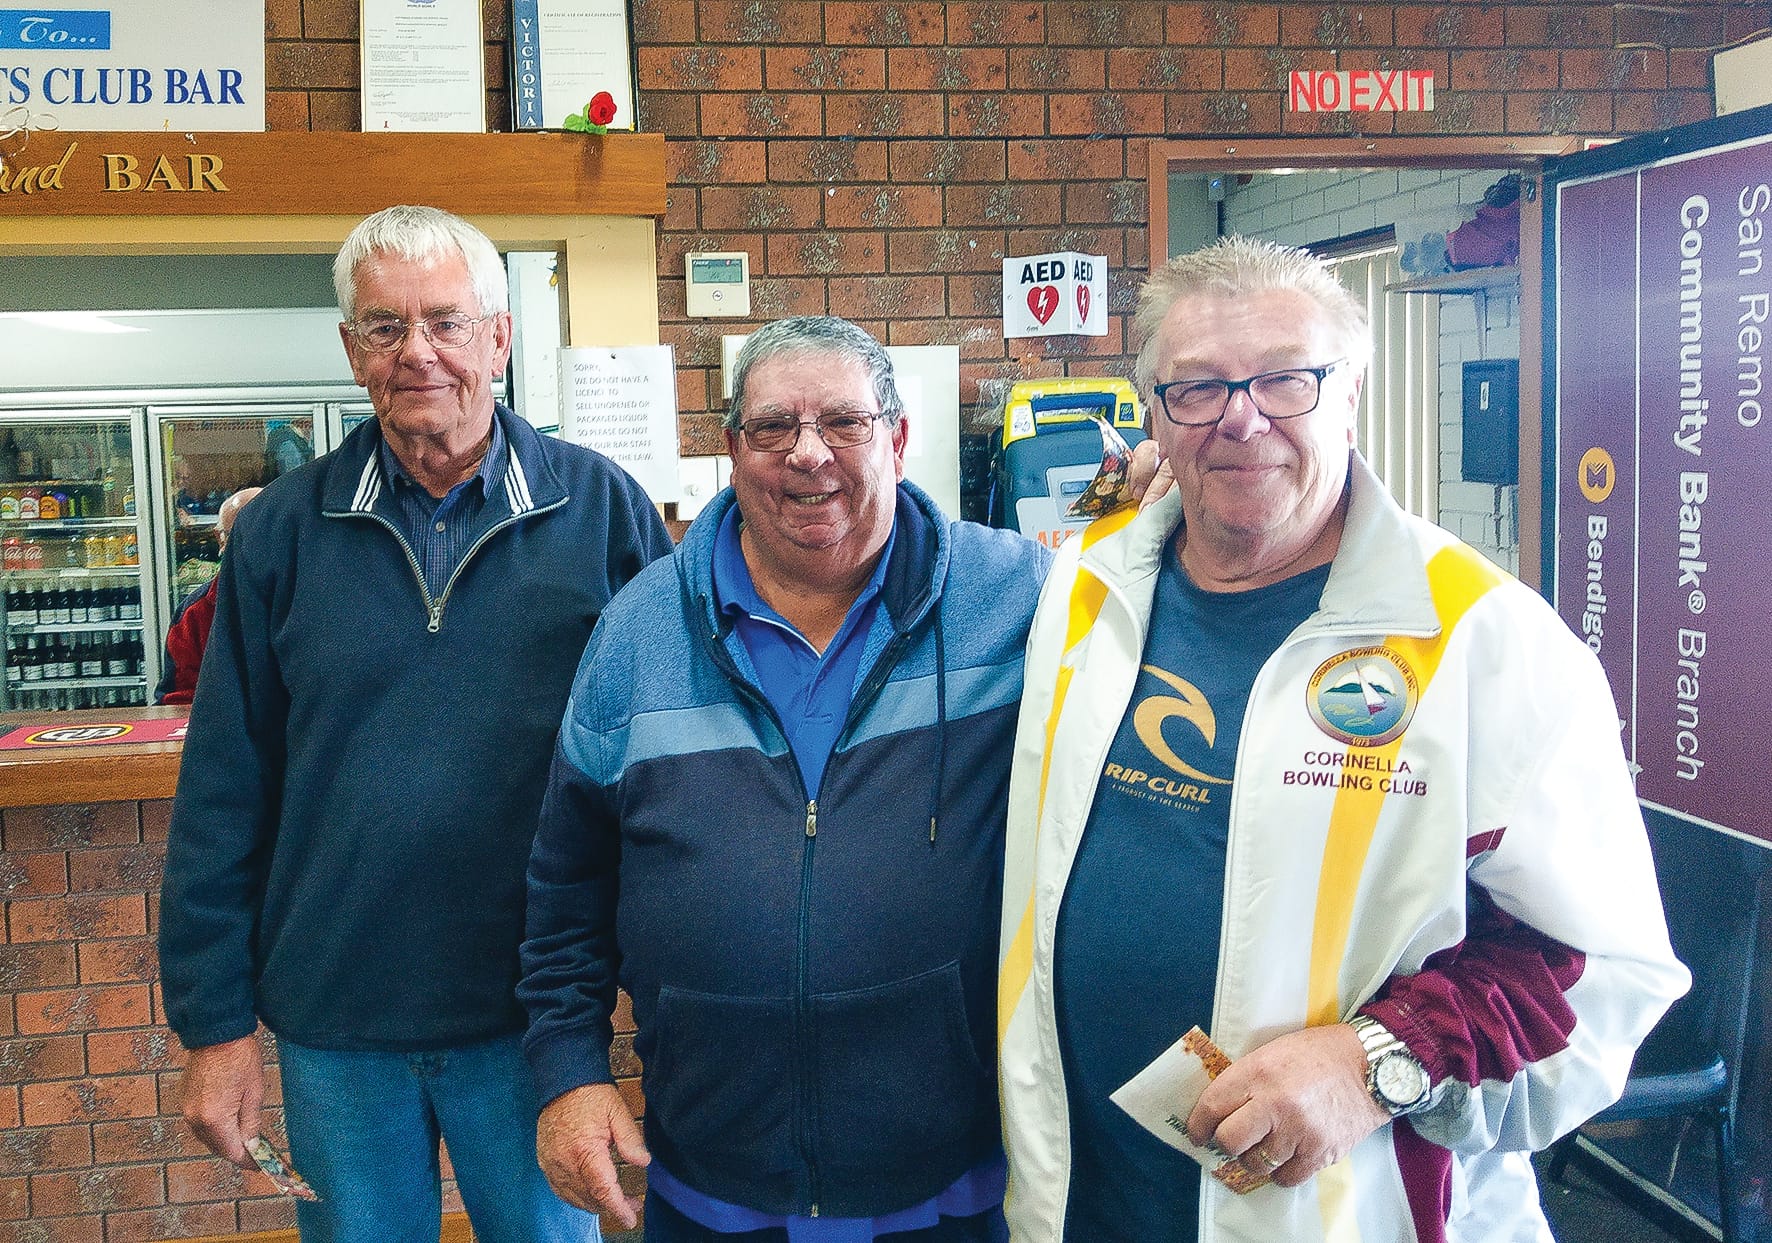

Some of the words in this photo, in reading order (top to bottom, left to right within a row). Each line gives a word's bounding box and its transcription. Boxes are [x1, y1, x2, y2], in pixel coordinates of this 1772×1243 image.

[19, 17, 96, 43] To...
[42, 67, 153, 105] CLUB
[163, 68, 246, 105] BAR
[520, 18, 537, 127] VICTORIA
[1290, 70, 1341, 112] NO
[1350, 70, 1434, 112] EXIT
[100, 153, 231, 193] BAR
[1738, 184, 1772, 276] San
[1020, 260, 1066, 284] AED
[1073, 259, 1093, 281] AED
[1674, 194, 1710, 457] Community
[1737, 293, 1770, 428] Remo
[574, 377, 588, 385] WE
[603, 376, 619, 384] NOT
[621, 376, 641, 384] HAVE
[643, 375, 649, 383] A
[608, 388, 619, 396] TO
[575, 402, 593, 410] SELL
[594, 401, 637, 409] UNOPENED
[638, 400, 650, 408] OR
[576, 415, 617, 423] PACKAGED
[619, 413, 648, 422] LIQUOR
[577, 428, 588, 437] SO
[590, 428, 616, 436] PLEASE
[618, 427, 630, 435] DO
[632, 426, 648, 434] NOT
[594, 441, 611, 449] OUR
[613, 440, 629, 448] BAR
[630, 439, 652, 448] STAFF
[1582, 514, 1608, 654] Bendigo
[1675, 628, 1707, 781] Branch
[1304, 751, 1412, 774] CORINELLA
[1104, 762, 1149, 785] RIP
[1147, 776, 1212, 805] CURL
[1283, 770, 1373, 791] BOWLING
[1379, 777, 1428, 797] CLUB
